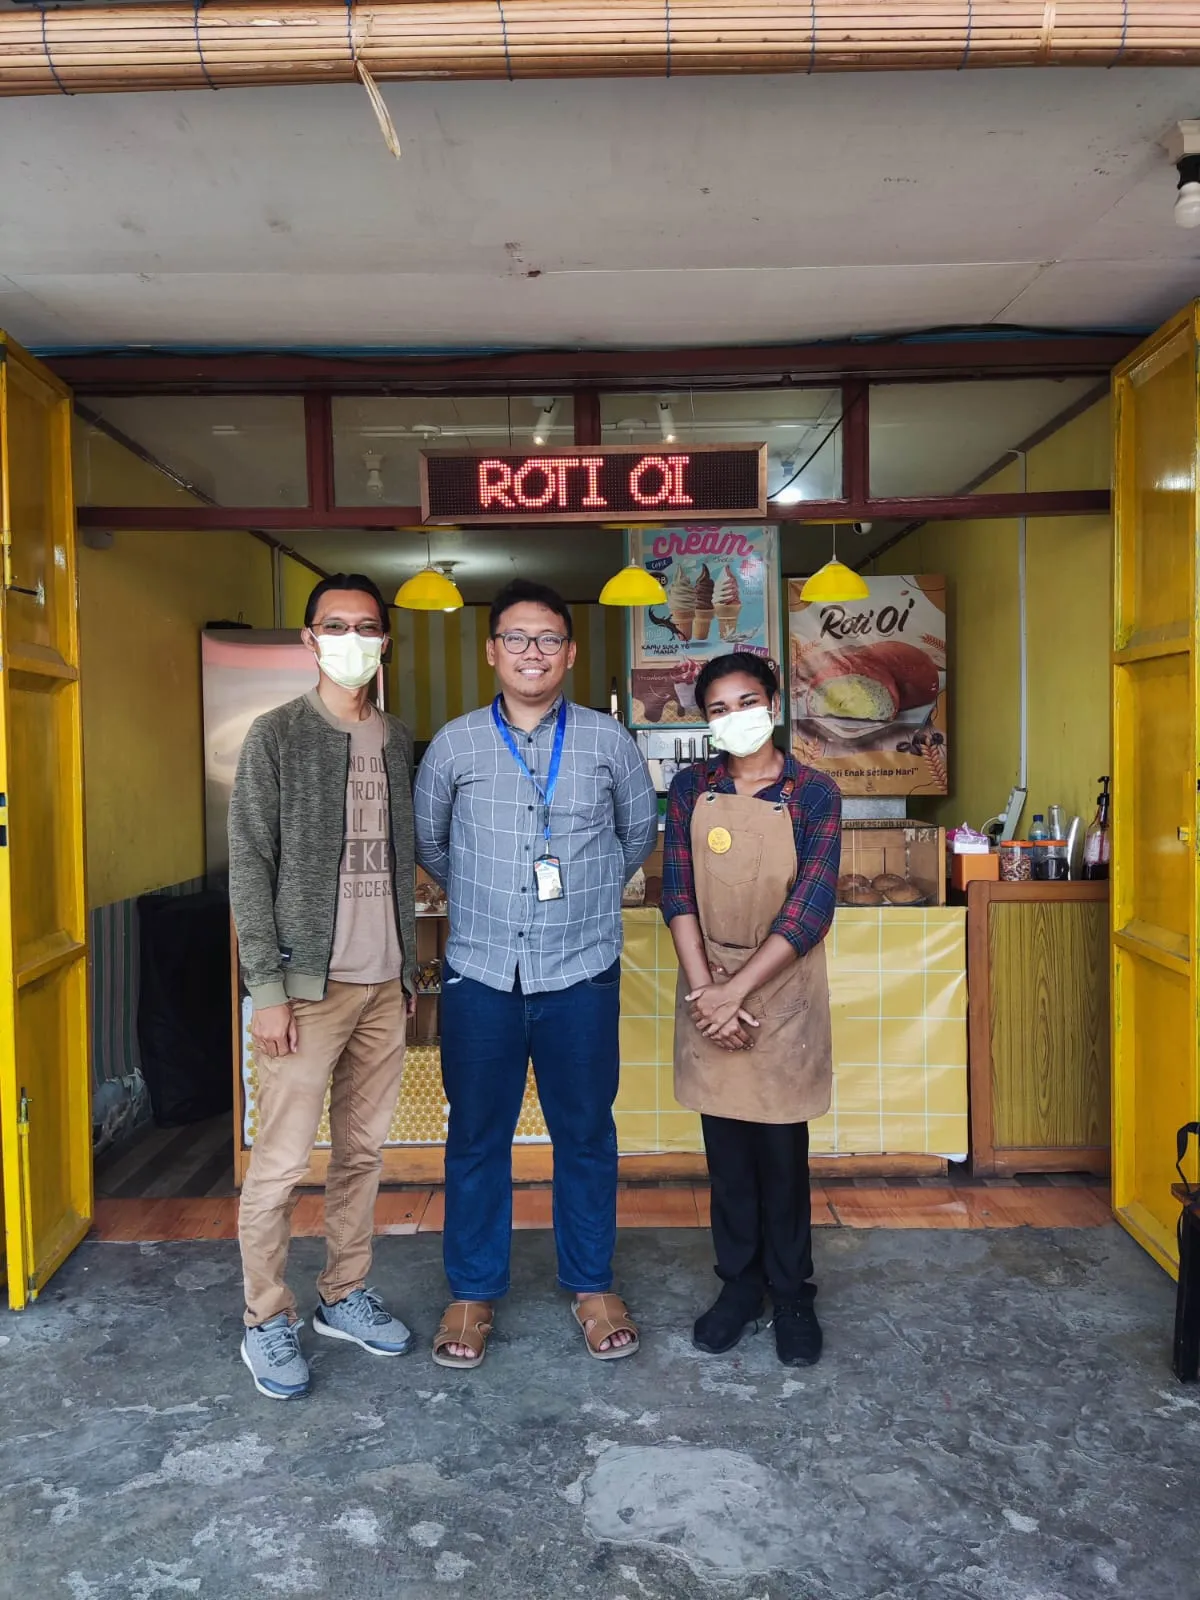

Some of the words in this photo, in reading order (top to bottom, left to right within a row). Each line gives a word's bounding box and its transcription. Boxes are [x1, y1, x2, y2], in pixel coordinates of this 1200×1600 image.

[478, 458, 607, 508] ROTI
[630, 456, 693, 505] OI
[652, 532, 754, 558] cream
[820, 605, 874, 639] Roti
[876, 598, 915, 634] Oi
[844, 769, 865, 777] Enak
